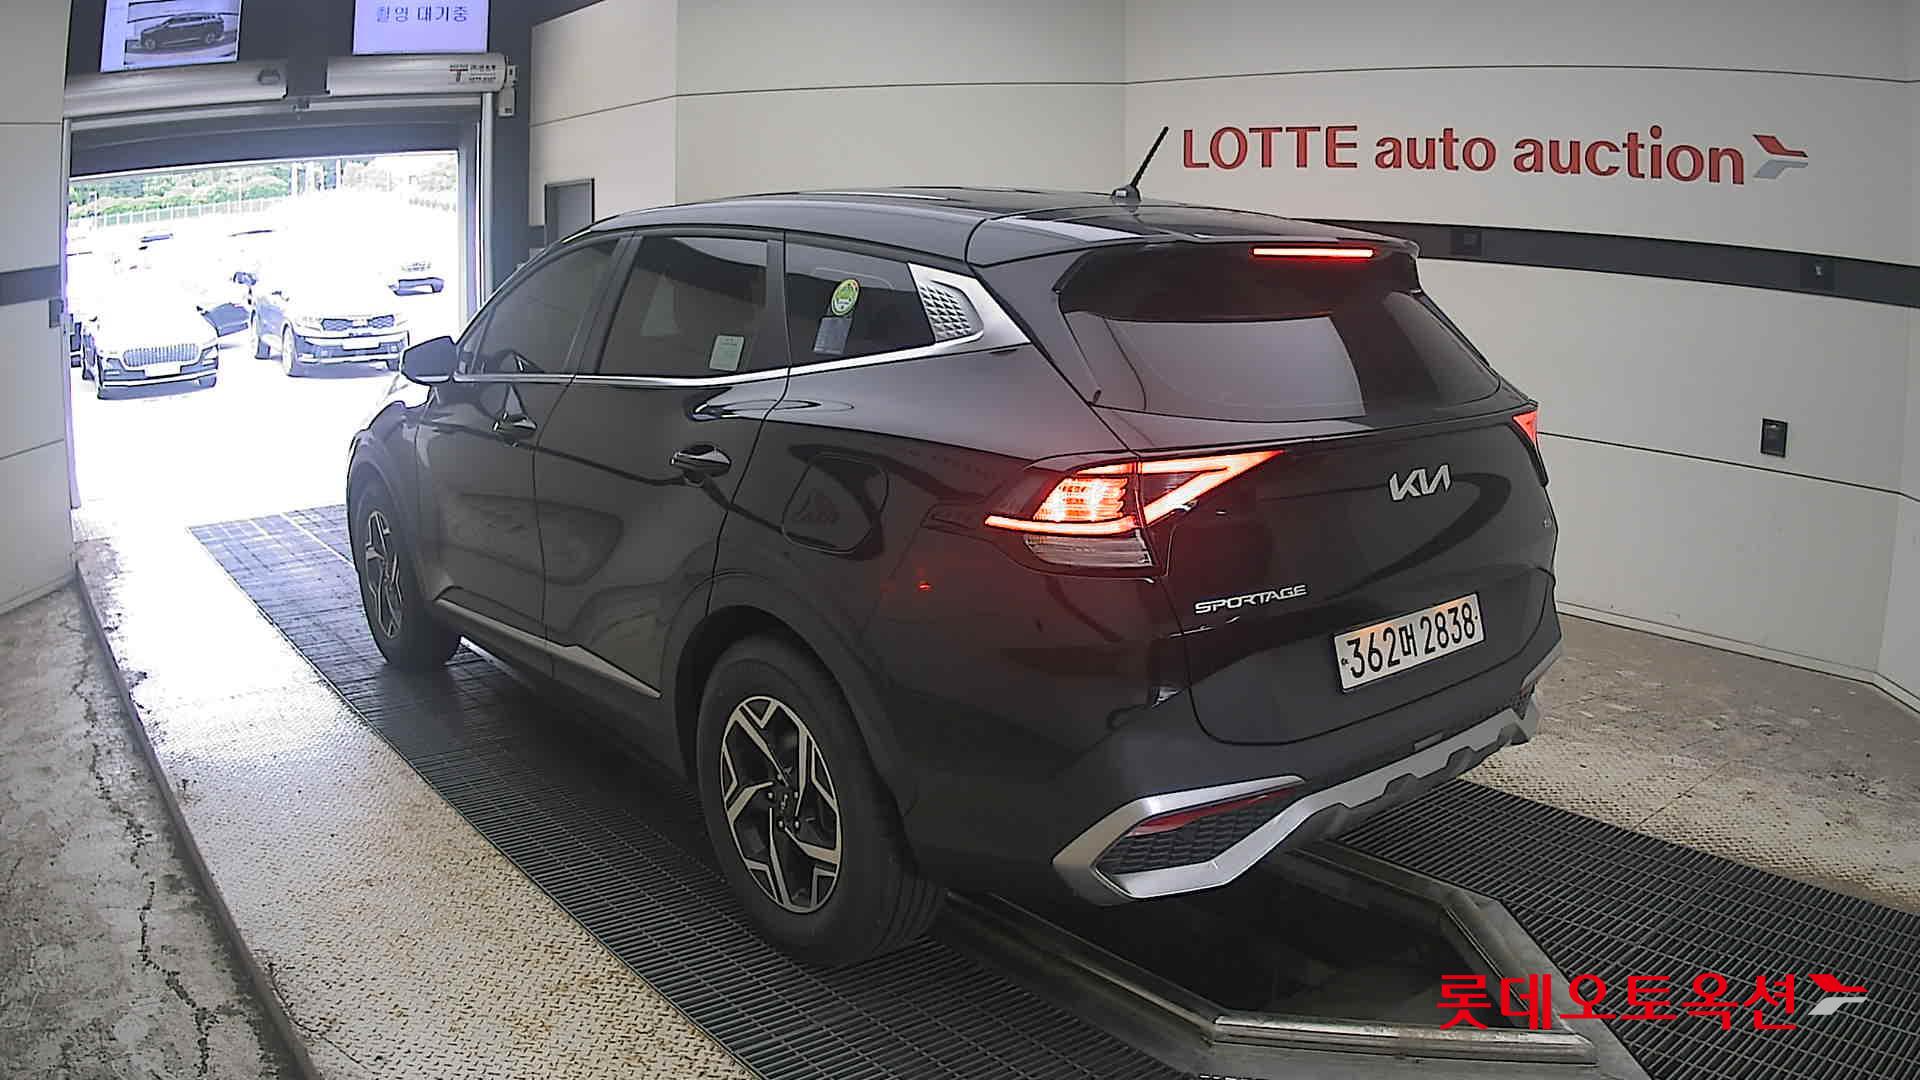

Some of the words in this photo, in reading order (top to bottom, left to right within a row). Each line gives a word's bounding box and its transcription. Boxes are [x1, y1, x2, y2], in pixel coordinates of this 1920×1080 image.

[417, 5, 467, 22] 대기중
[1183, 125, 1358, 170] LOTTE
[1374, 127, 1497, 171] auto
[1513, 125, 1745, 185] auction
[1389, 463, 1451, 501] KIA
[1194, 584, 1308, 614] SPORTAGE
[1346, 621, 1418, 678] 362머
[1420, 602, 1476, 655] 2838
